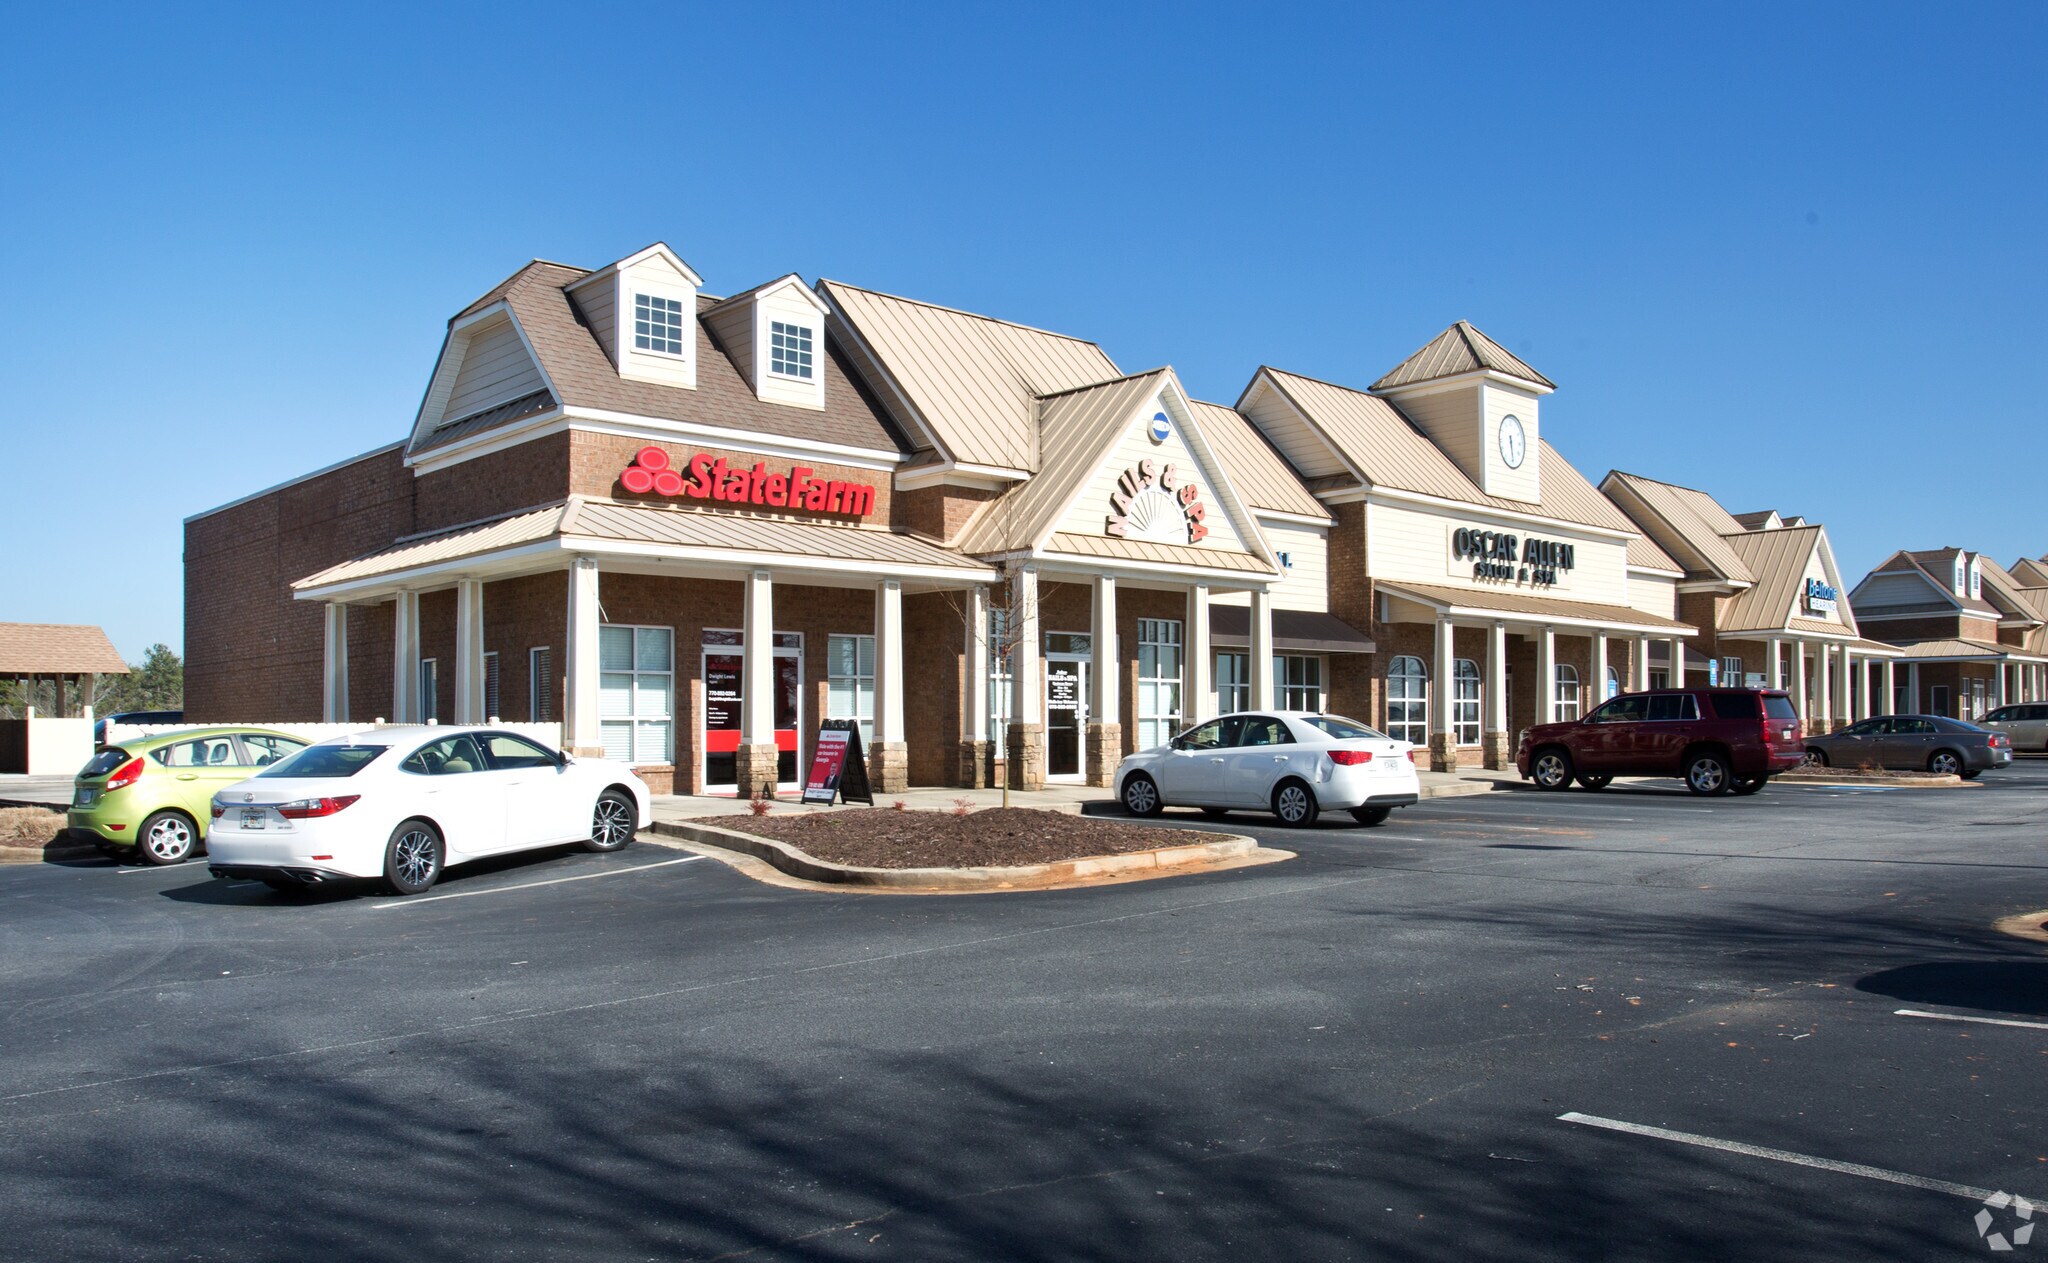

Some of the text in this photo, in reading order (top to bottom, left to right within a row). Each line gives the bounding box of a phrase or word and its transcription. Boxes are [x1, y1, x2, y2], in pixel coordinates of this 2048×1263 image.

[1104, 459, 1208, 544] NAILS & SPA
[1453, 527, 1574, 569] OSCAR ALLEN
[1474, 562, 1557, 584] SALON & SPA
[1806, 577, 1837, 601] Beltone
[1810, 598, 1837, 611] HEARING
